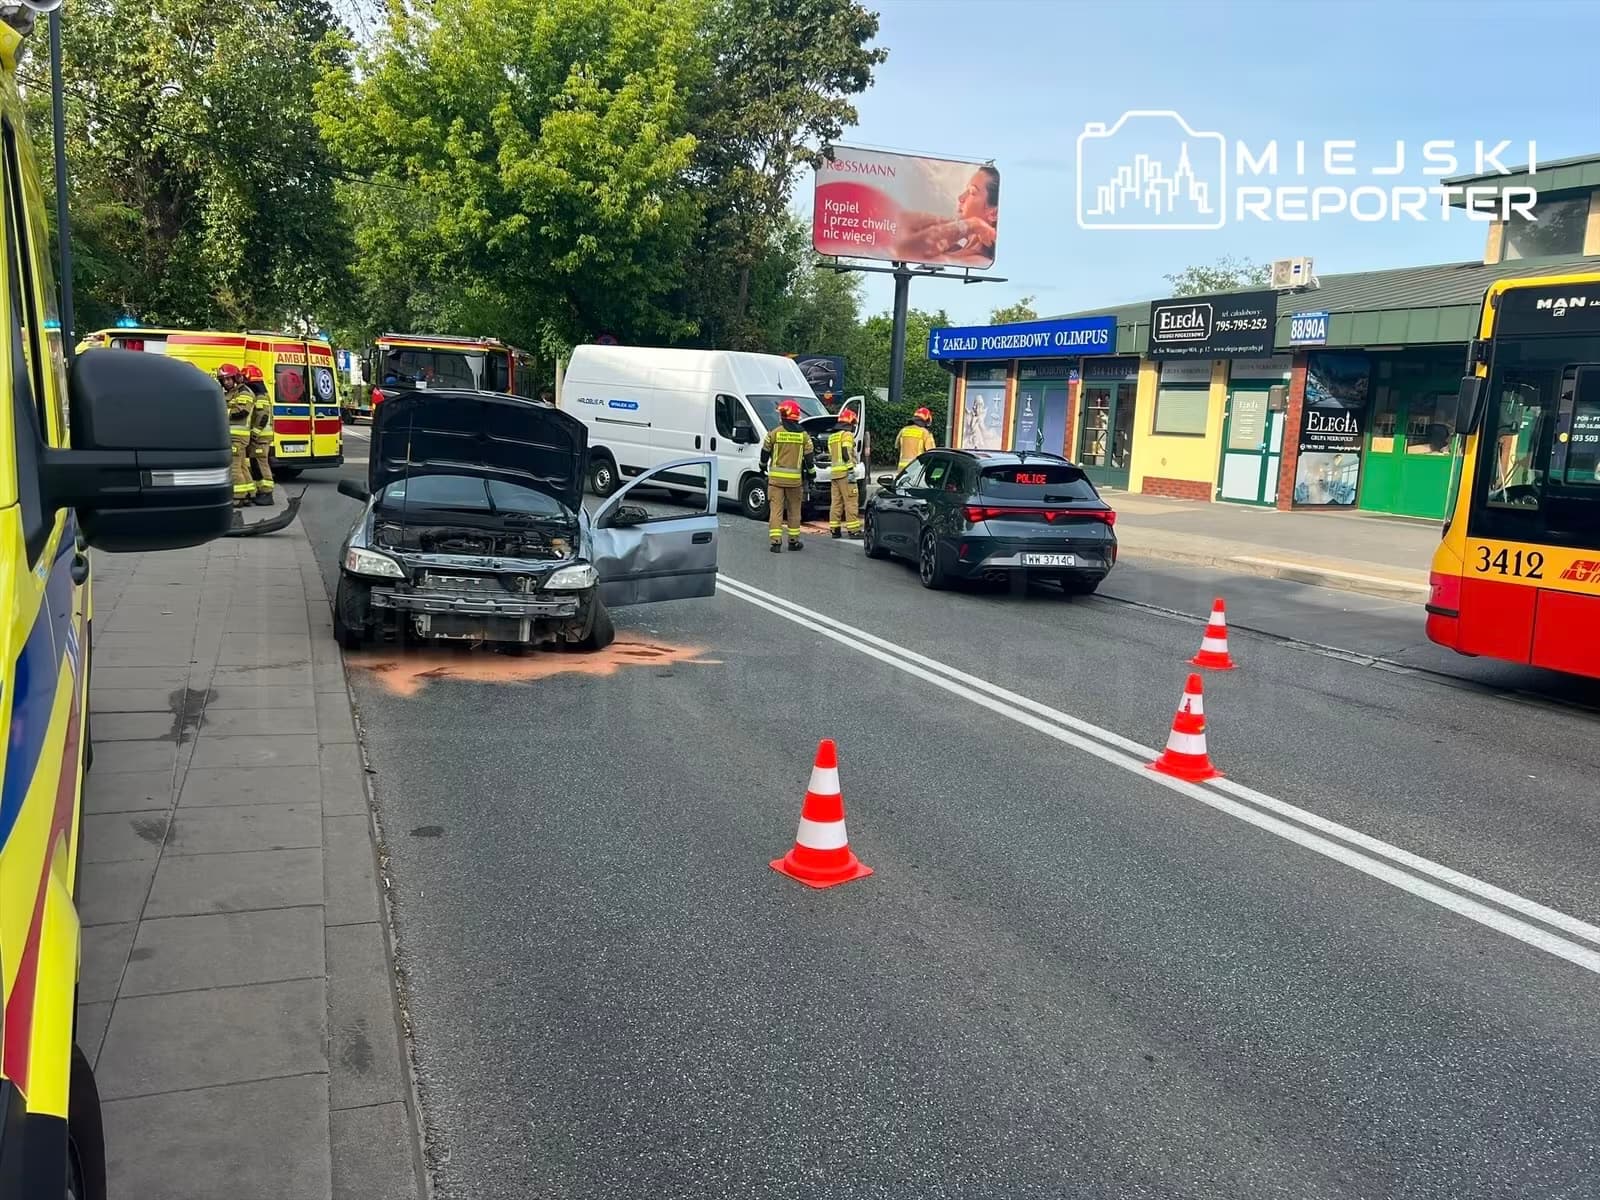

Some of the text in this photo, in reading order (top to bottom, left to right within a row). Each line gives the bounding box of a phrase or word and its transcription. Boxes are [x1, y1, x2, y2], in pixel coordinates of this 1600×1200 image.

[826, 159, 896, 178] ROSSMANN
[824, 199, 860, 215] Kąpiel
[823, 213, 897, 235] i przez chwilę
[823, 227, 876, 246] nic więcej
[1536, 297, 1586, 310] MAN
[1215, 318, 1268, 332] 795-795-252
[1291, 318, 1326, 339] 88/90A
[943, 328, 1108, 351] ZAKŁAD POGRZEBOWY OLIMPUS
[277, 352, 331, 366] AMBULANS
[1016, 473, 1047, 484] POLICE
[1475, 545, 1544, 579] 3412
